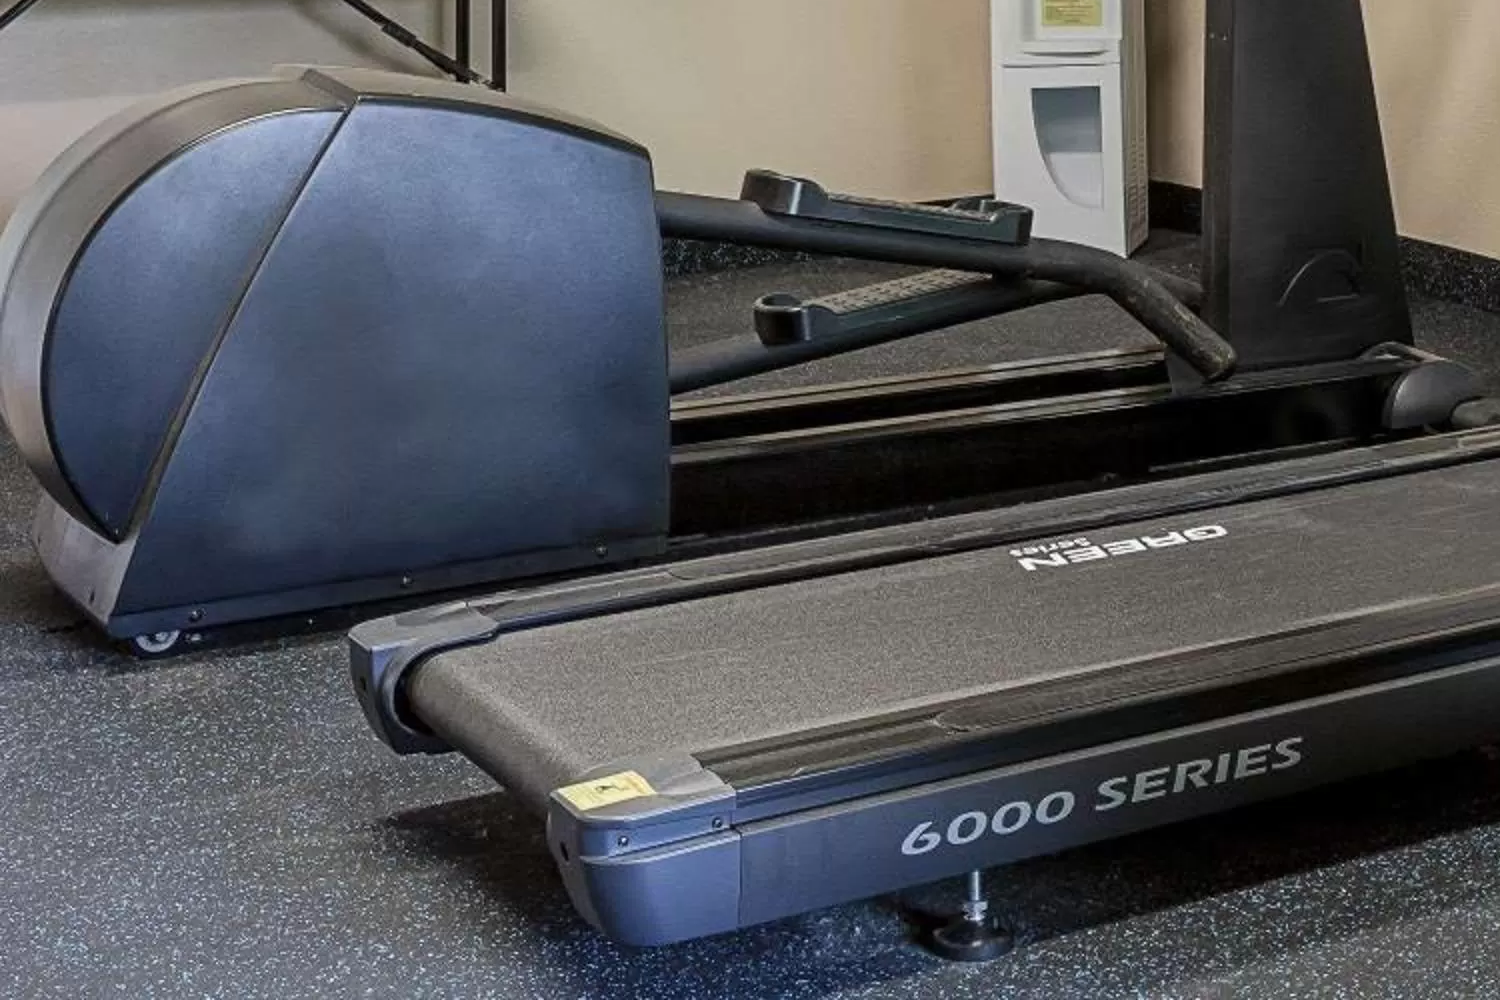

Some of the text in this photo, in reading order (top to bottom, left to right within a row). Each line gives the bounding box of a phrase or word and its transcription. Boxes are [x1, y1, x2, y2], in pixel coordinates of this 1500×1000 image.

[1018, 525, 1228, 571] GREEN
[901, 738, 1303, 855] 6000 SERIES
